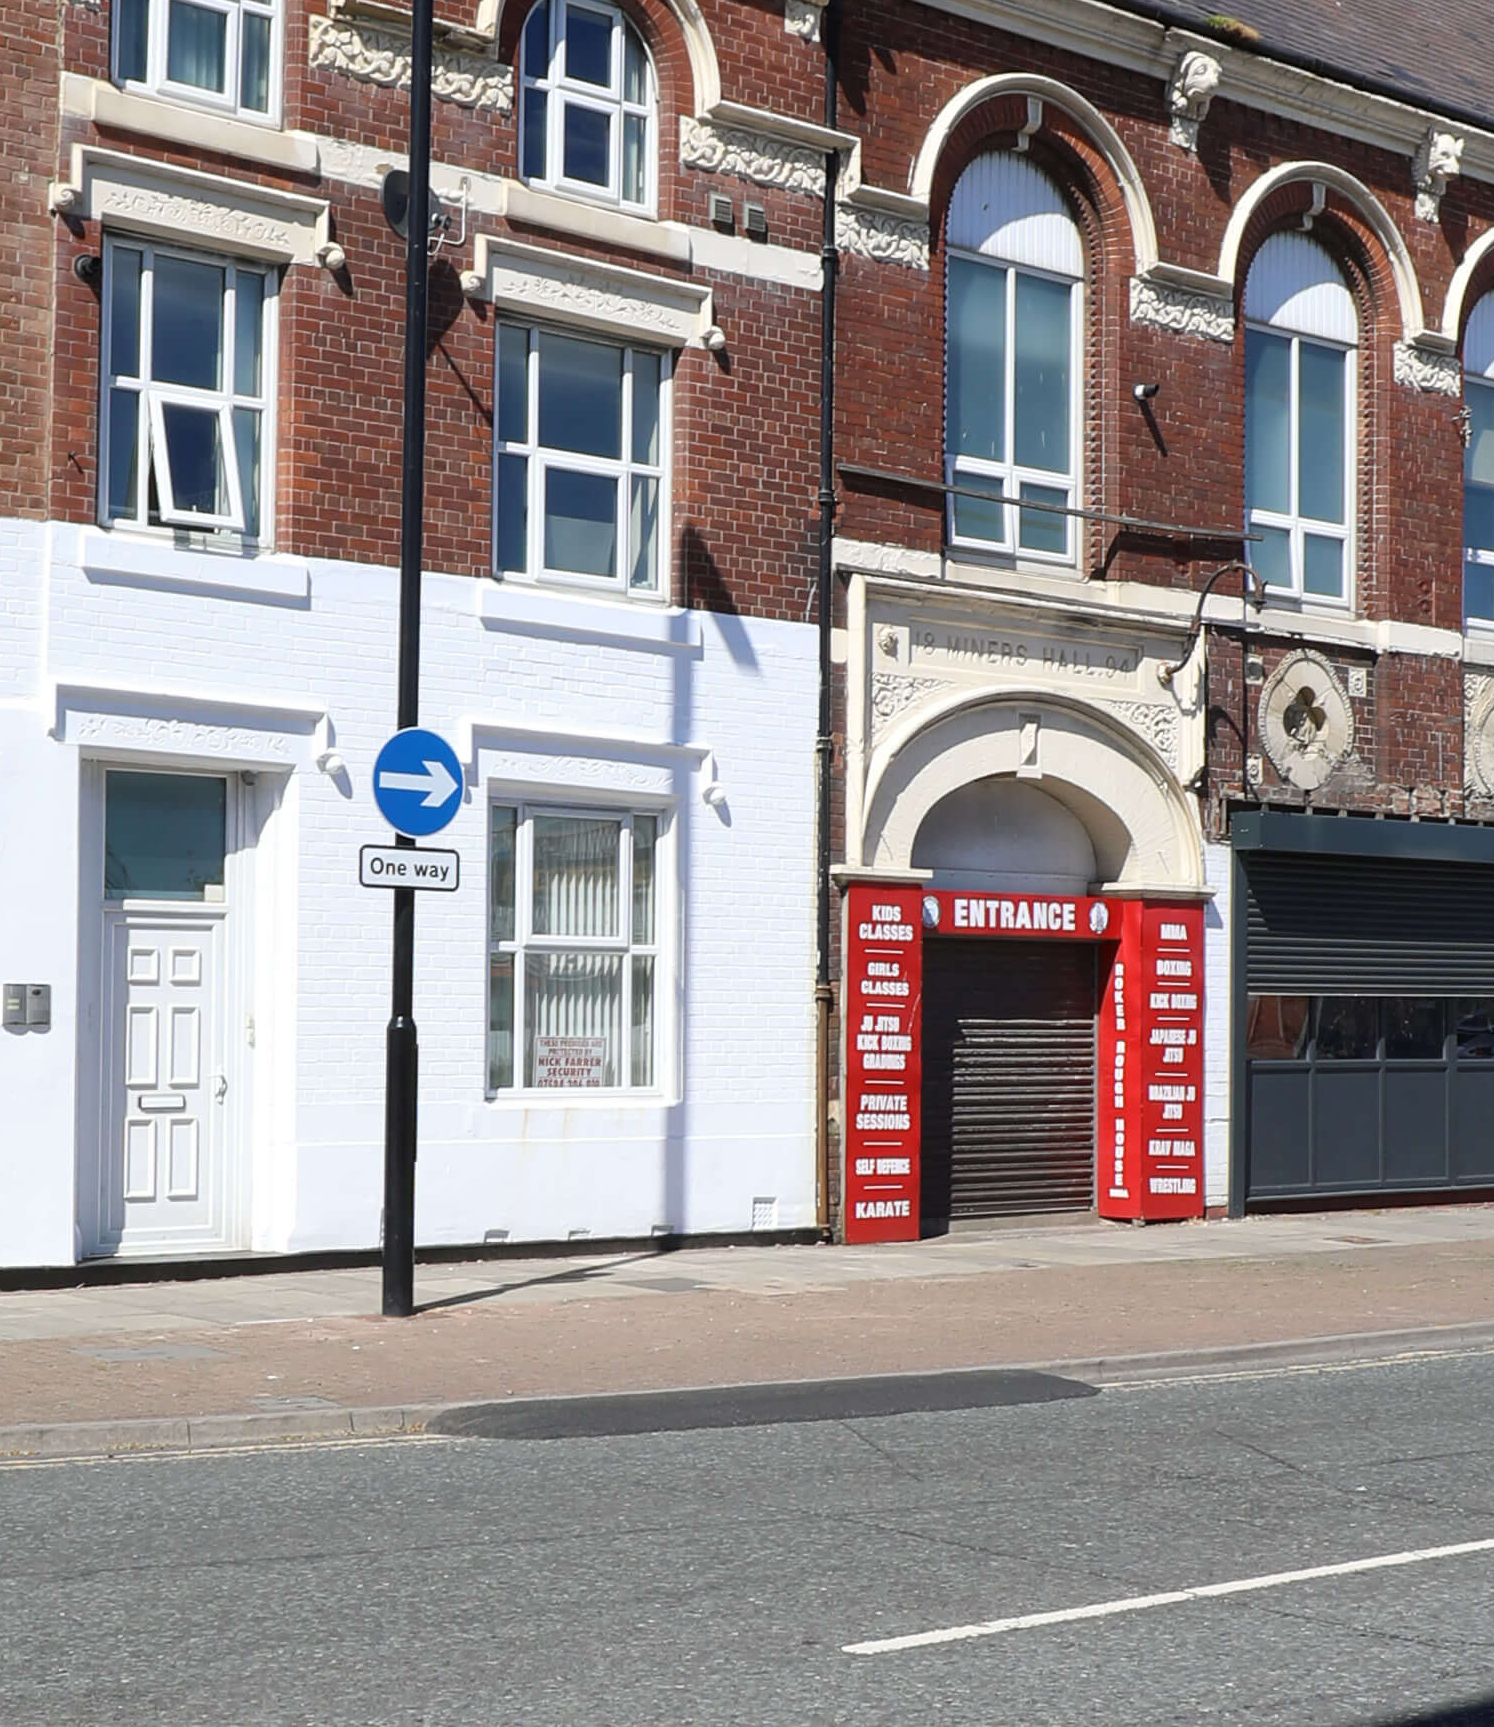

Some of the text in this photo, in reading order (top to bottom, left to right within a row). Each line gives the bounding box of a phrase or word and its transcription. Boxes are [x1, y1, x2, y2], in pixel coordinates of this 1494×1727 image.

[947, 636, 1028, 666] MINERS
[370, 857, 450, 882] One way
[871, 904, 902, 922] KIDS
[954, 898, 1076, 931] ENTRANCE
[859, 923, 914, 941] CLASSES
[1160, 924, 1188, 940] MMA
[867, 962, 900, 977] GIRLS
[1156, 959, 1192, 976] BOXING
[860, 980, 910, 996] CLASSES
[1114, 963, 1126, 1030] ROKER
[547, 1068, 592, 1077] SECURITY
[860, 1094, 908, 1111] PRIVATE
[856, 1113, 911, 1130] SESSIONS
[855, 1200, 911, 1219] KARATE
